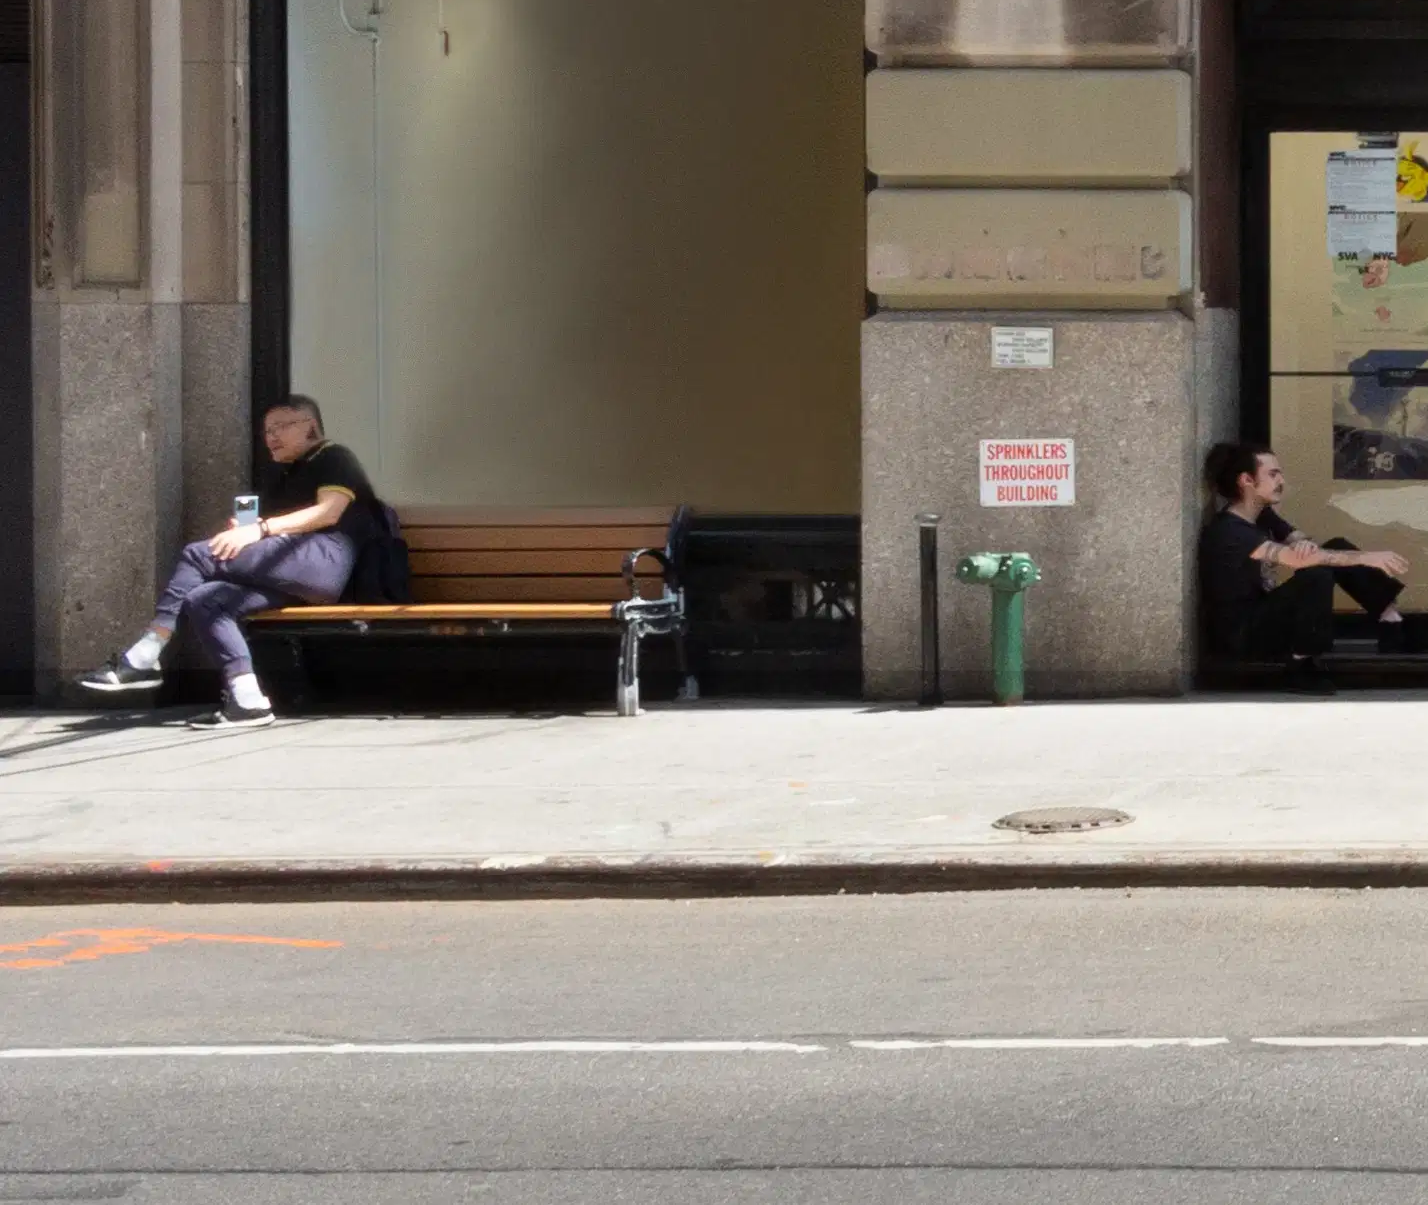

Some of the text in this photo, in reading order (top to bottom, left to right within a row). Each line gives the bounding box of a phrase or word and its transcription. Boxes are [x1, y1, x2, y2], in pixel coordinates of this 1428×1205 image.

[1338, 251, 1358, 260] SVA
[986, 443, 1067, 461] SPRINKLERS
[984, 464, 1071, 481] THROUGHOUT
[996, 485, 1058, 501] BUILDING
